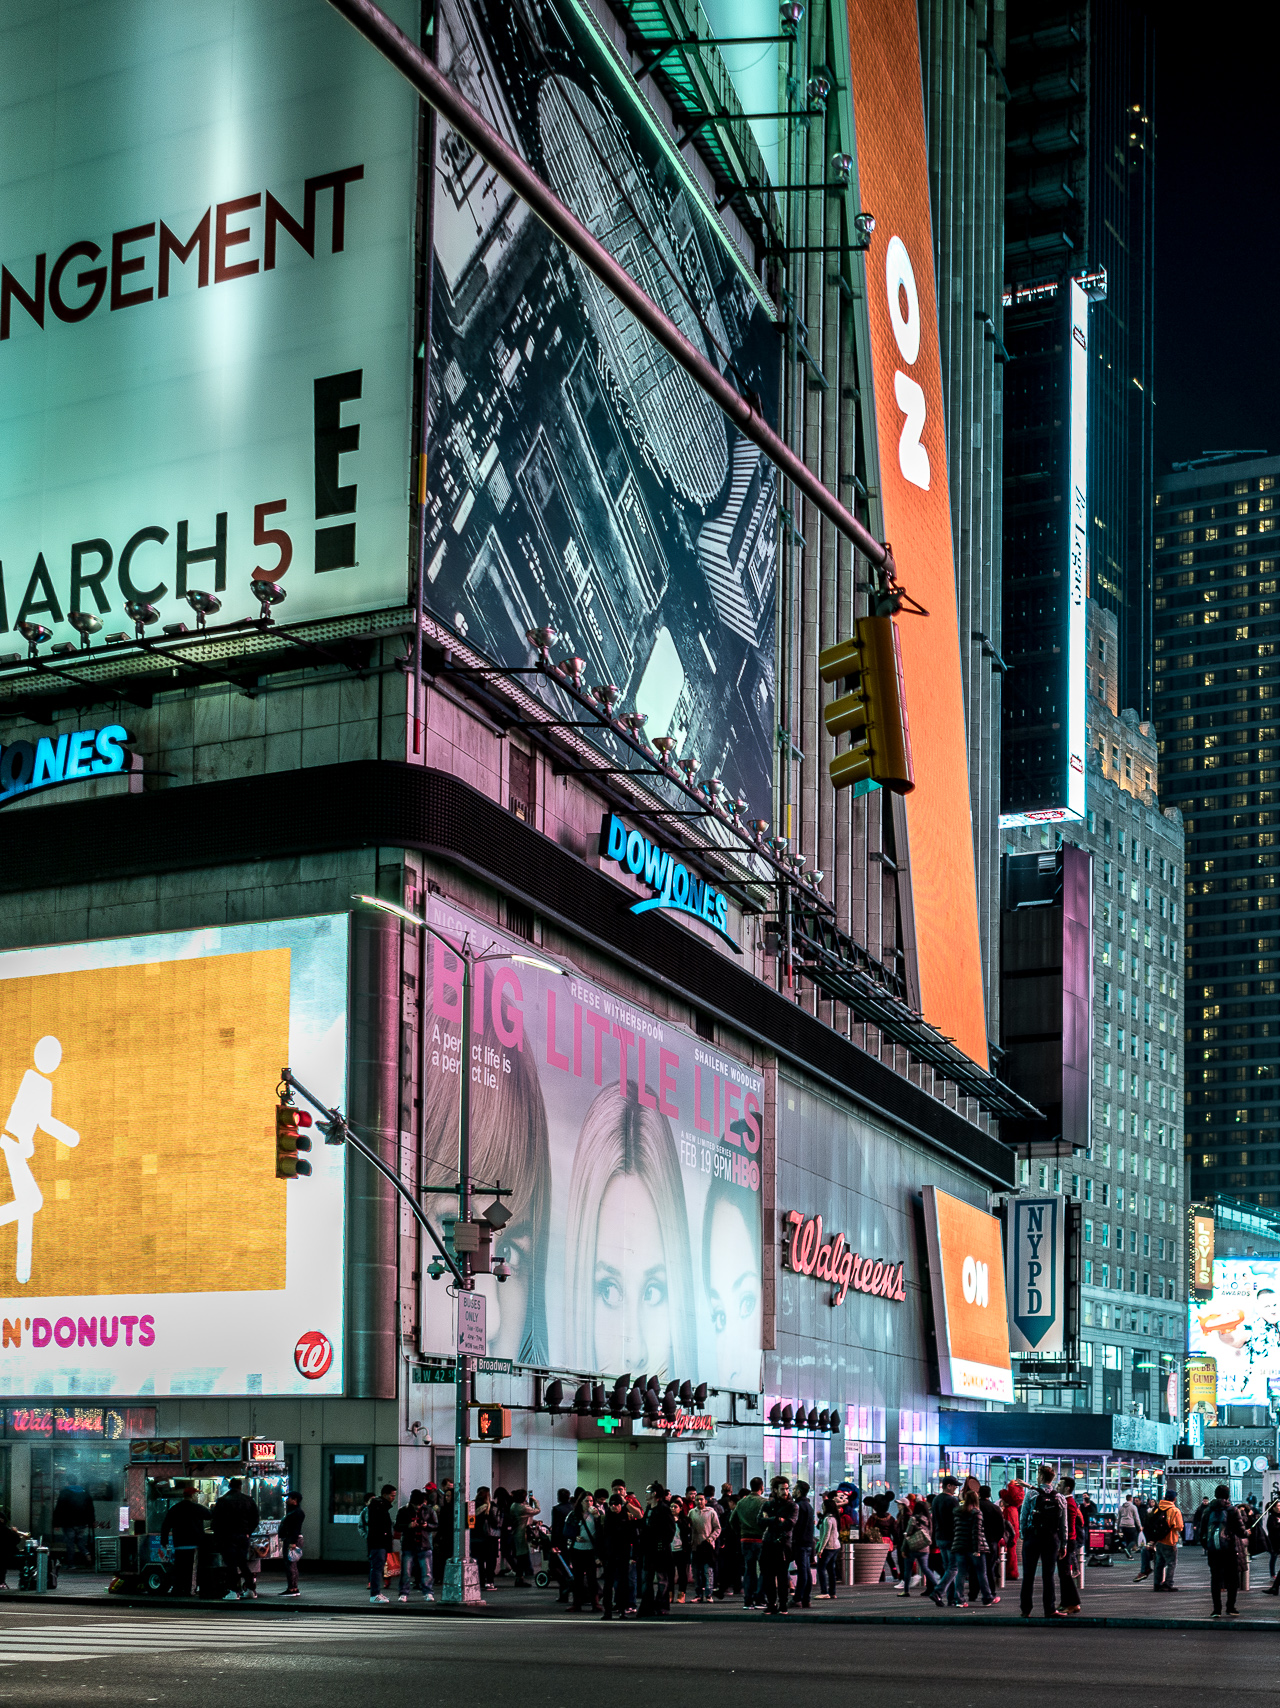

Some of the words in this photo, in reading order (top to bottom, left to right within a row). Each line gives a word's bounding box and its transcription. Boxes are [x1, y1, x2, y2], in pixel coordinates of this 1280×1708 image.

[0, 164, 364, 341] NGEMENT
[251, 498, 293, 583] 5
[0, 724, 128, 791] ONES
[571, 982, 600, 1010] REESE
[604, 1000, 664, 1043] WITHERSPOON
[432, 1024, 441, 1045] A
[443, 1032, 482, 1063] perct
[485, 1046, 500, 1068] life
[502, 1054, 512, 1074] is
[433, 934, 523, 1053] BIG
[547, 989, 680, 1121] LITTLE
[694, 1065, 761, 1154] LIES
[432, 1050, 440, 1066] a
[442, 1054, 481, 1084] perct
[484, 1069, 499, 1090] lie.
[694, 1048, 729, 1077] SHAILENE
[730, 1066, 761, 1093] WOODLEY
[680, 1139, 697, 1169] FEB
[700, 1149, 711, 1174] 19
[713, 1153, 732, 1182] 9PM
[732, 1152, 760, 1192] HBO
[686, 1132, 696, 1142] NEW
[697, 1136, 715, 1151] LIMITED
[716, 1144, 732, 1158] SERIES
[787, 1210, 907, 1306] Walgreens
[1027, 1207, 1045, 1315] NYPD
[463, 1297, 481, 1310] BUSES
[962, 1255, 990, 1309] ON
[465, 1311, 479, 1323] ONLY
[423, 1370, 431, 1382] W
[434, 1370, 445, 1382] 42
[478, 1359, 511, 1374] Broadway
[1193, 1373, 1215, 1384] GUMP
[1241, 1439, 1275, 1447] FORCES
[1167, 1466, 1227, 1474] SANDWICHES
